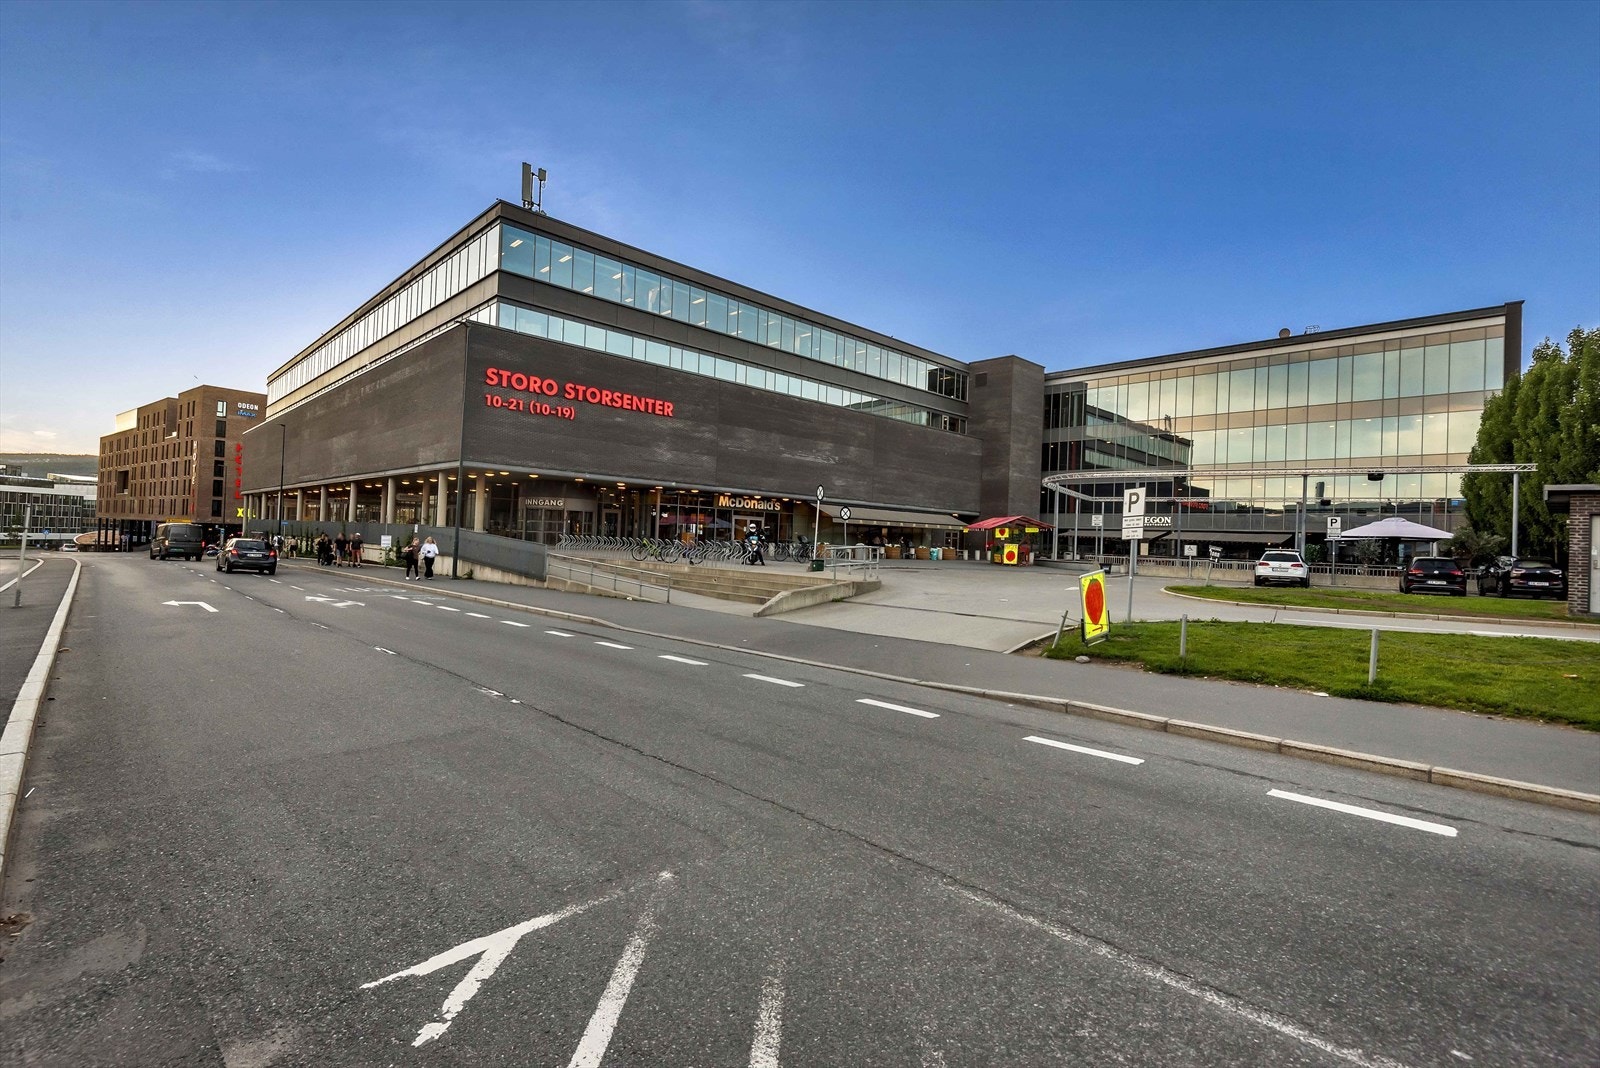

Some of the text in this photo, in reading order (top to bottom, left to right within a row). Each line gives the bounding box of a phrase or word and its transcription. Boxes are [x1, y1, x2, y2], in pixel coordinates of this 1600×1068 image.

[485, 367, 675, 417] STORO STORSENTER
[237, 402, 258, 411] ODEON
[485, 394, 576, 420] 10-21 (10-19)
[525, 498, 564, 507] INNGANG
[718, 495, 781, 511] McDonald's
[1127, 491, 1140, 513] P
[1144, 516, 1172, 524] EGON
[1330, 518, 1338, 527] P
